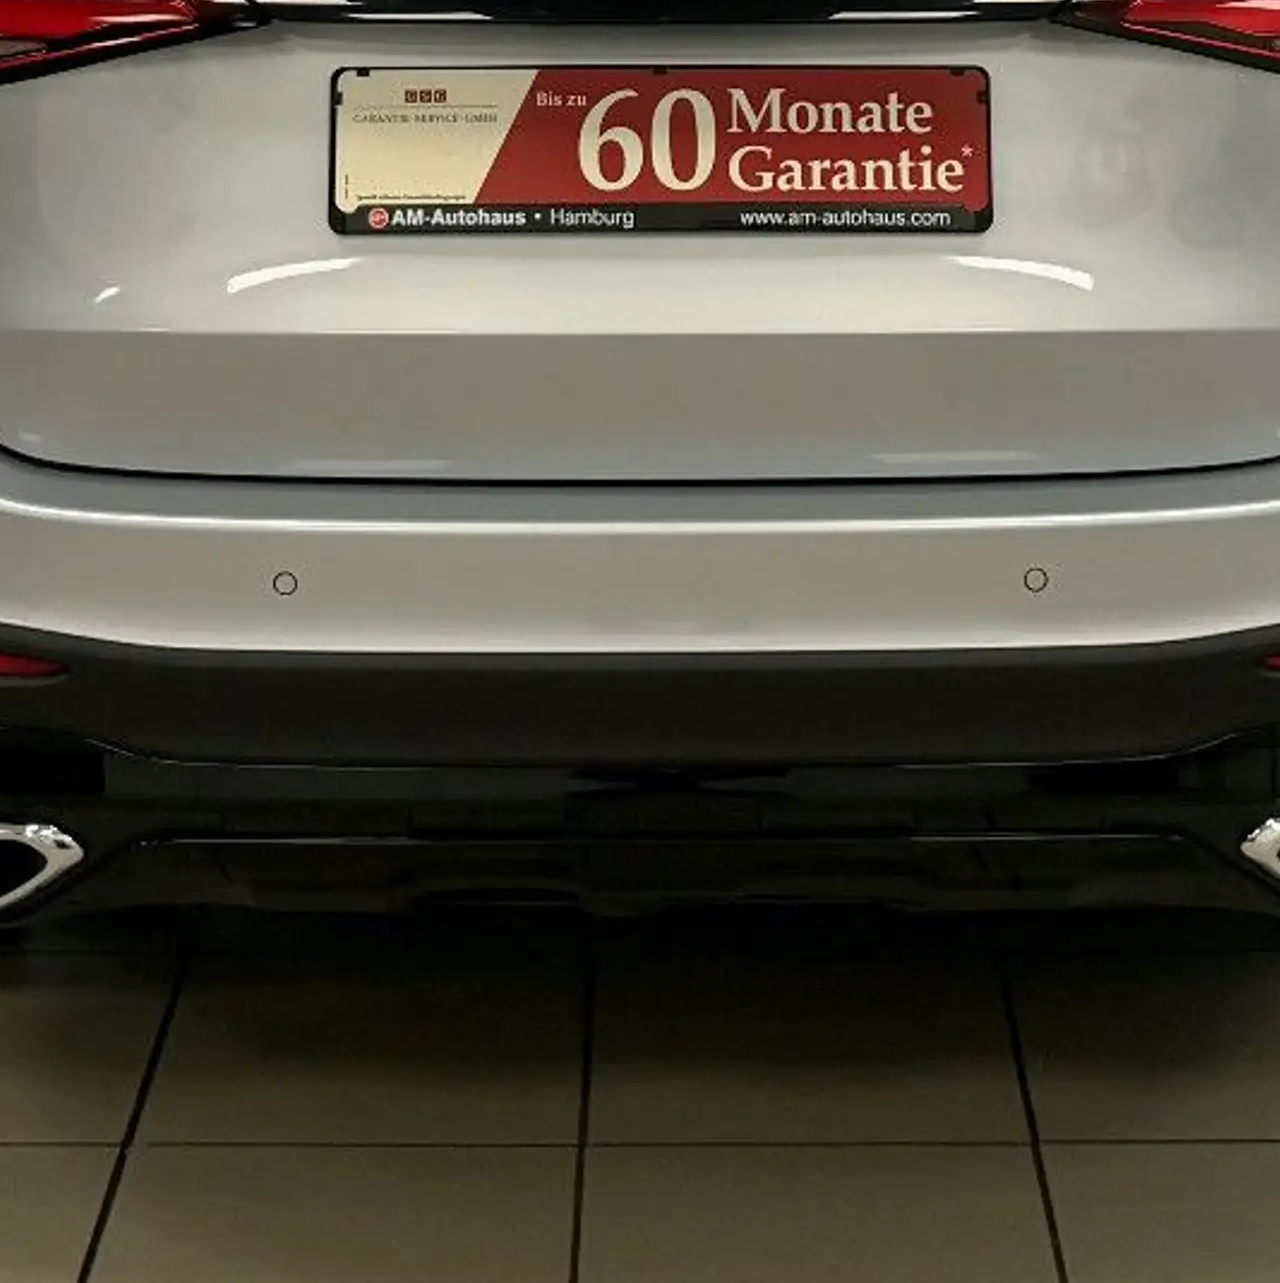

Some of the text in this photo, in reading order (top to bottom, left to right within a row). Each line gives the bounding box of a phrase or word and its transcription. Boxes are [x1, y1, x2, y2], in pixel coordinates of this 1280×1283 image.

[536, 87, 933, 192] Bis zu 60 Monate
[391, 208, 527, 227] AM-Autohaus
[550, 209, 634, 229] Hamburg
[740, 208, 951, 226] www.am-autohaus.com
